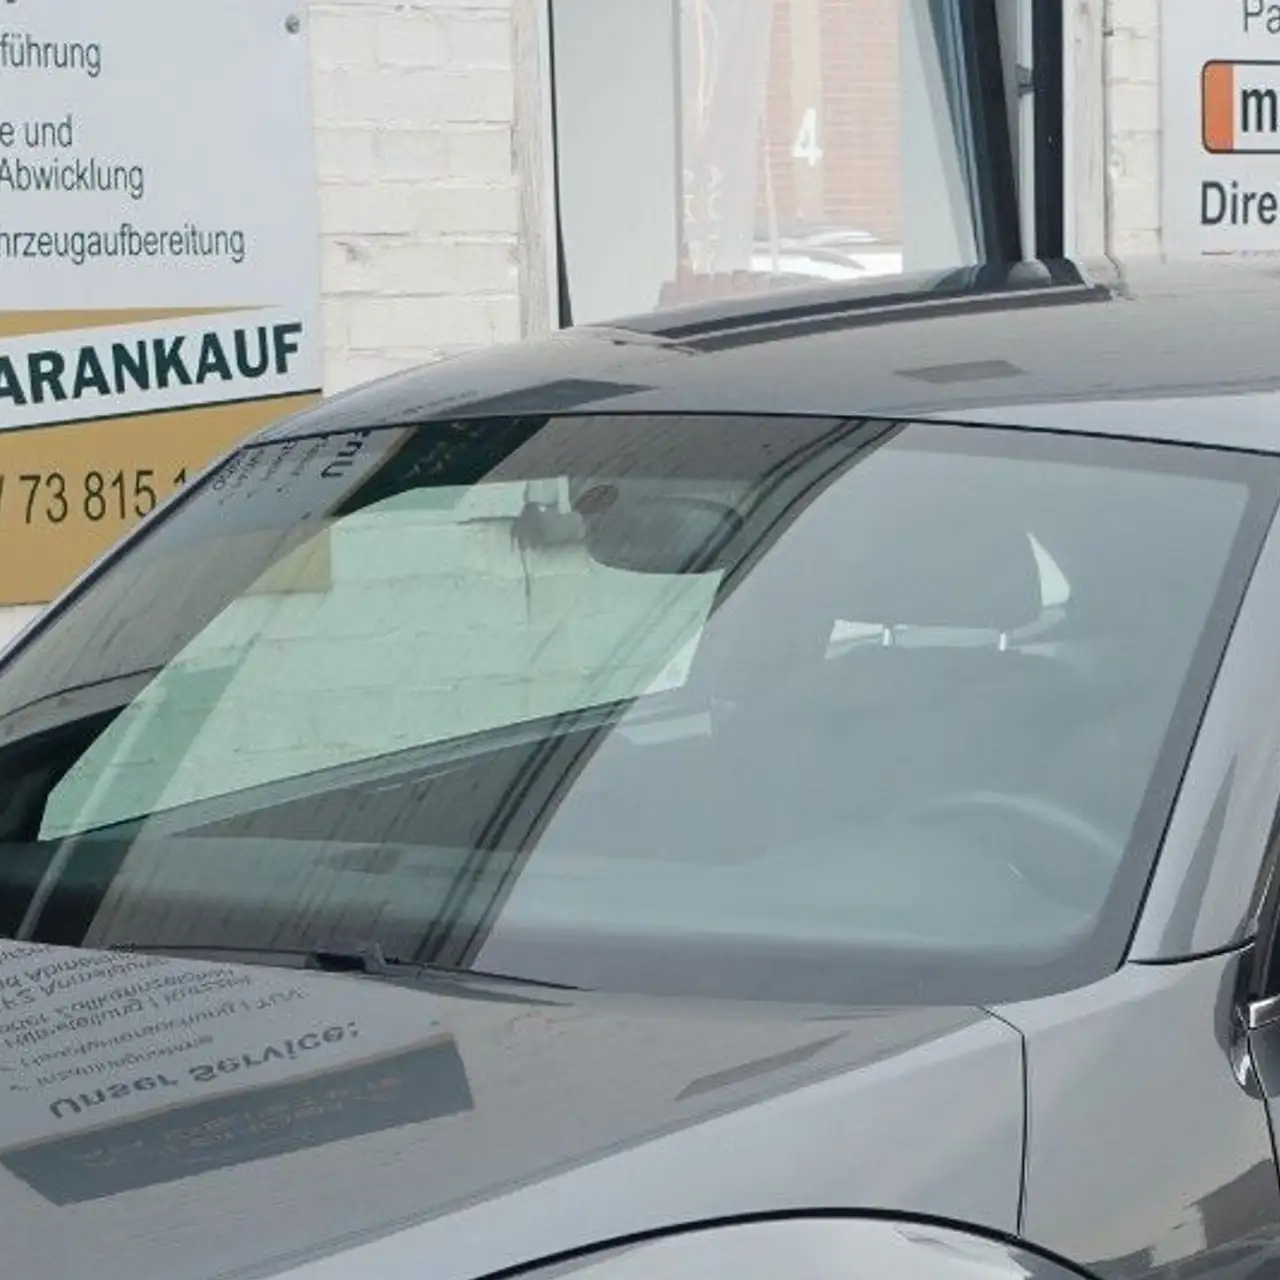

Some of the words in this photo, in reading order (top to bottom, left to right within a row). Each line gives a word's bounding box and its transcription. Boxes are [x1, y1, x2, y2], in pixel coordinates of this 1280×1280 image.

[23, 115, 73, 146] und
[19, 474, 69, 523] 73
[83, 469, 157, 521] 815
